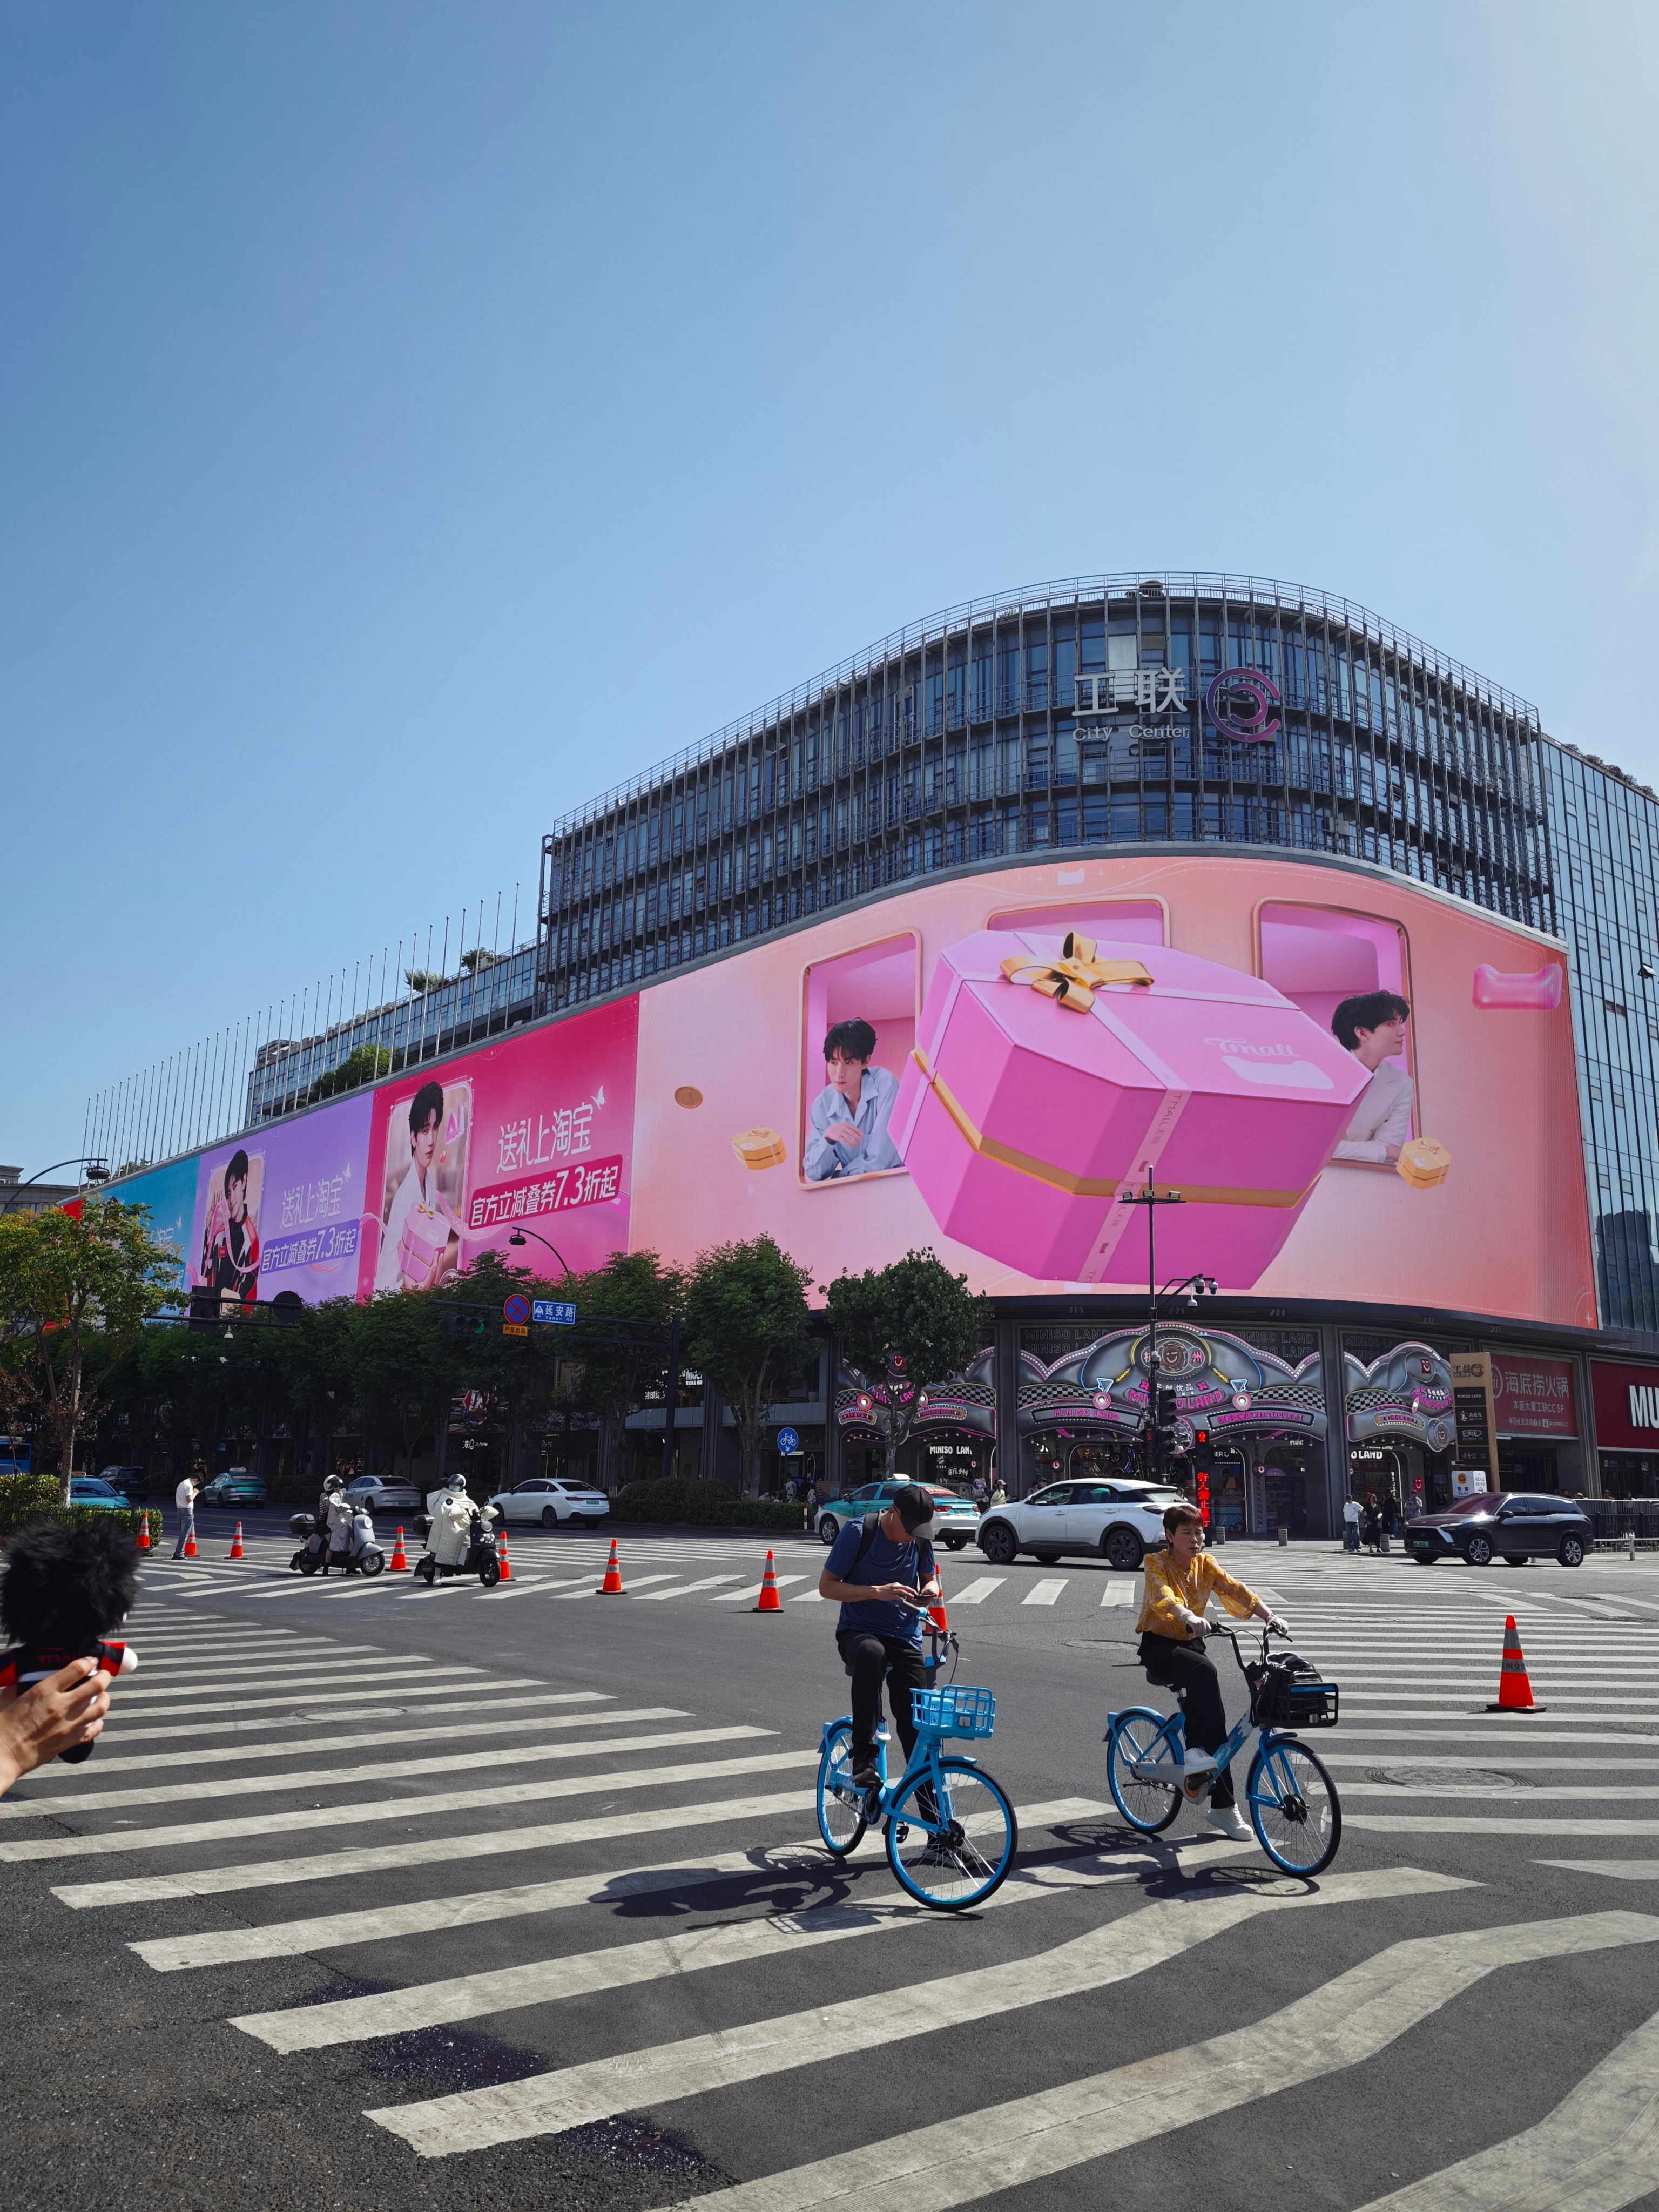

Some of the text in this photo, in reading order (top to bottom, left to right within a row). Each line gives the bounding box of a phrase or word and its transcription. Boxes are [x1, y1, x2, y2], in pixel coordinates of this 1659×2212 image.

[1071, 667, 1188, 717] 工联
[1073, 724, 1189, 742] City Center
[1204, 1037, 1300, 1057] Tmall
[496, 1102, 593, 1174] 送礼上淘宝
[280, 1175, 343, 1229] 送礼上淘宝
[470, 1166, 618, 1226] 官方立减叠券7.3折起
[261, 1227, 357, 1271] 官方立减叠券7.3折起
[545, 1305, 574, 1318] 延安路
[1025, 1329, 1070, 1340] MINISO
[1281, 1332, 1314, 1344] LAND
[1345, 1335, 1380, 1348] MINISO
[1192, 1351, 1202, 1363] 州
[1453, 1365, 1471, 1374] 工联
[1505, 1371, 1569, 1399] 海底捞火锅
[1187, 1391, 1223, 1410] LAND
[1054, 1408, 1120, 1421] MINISO LAND
[1557, 1404, 1564, 1413] 5F
[929, 1446, 972, 1455] MINISO LAN
[1358, 1451, 1383, 1459] LAND
